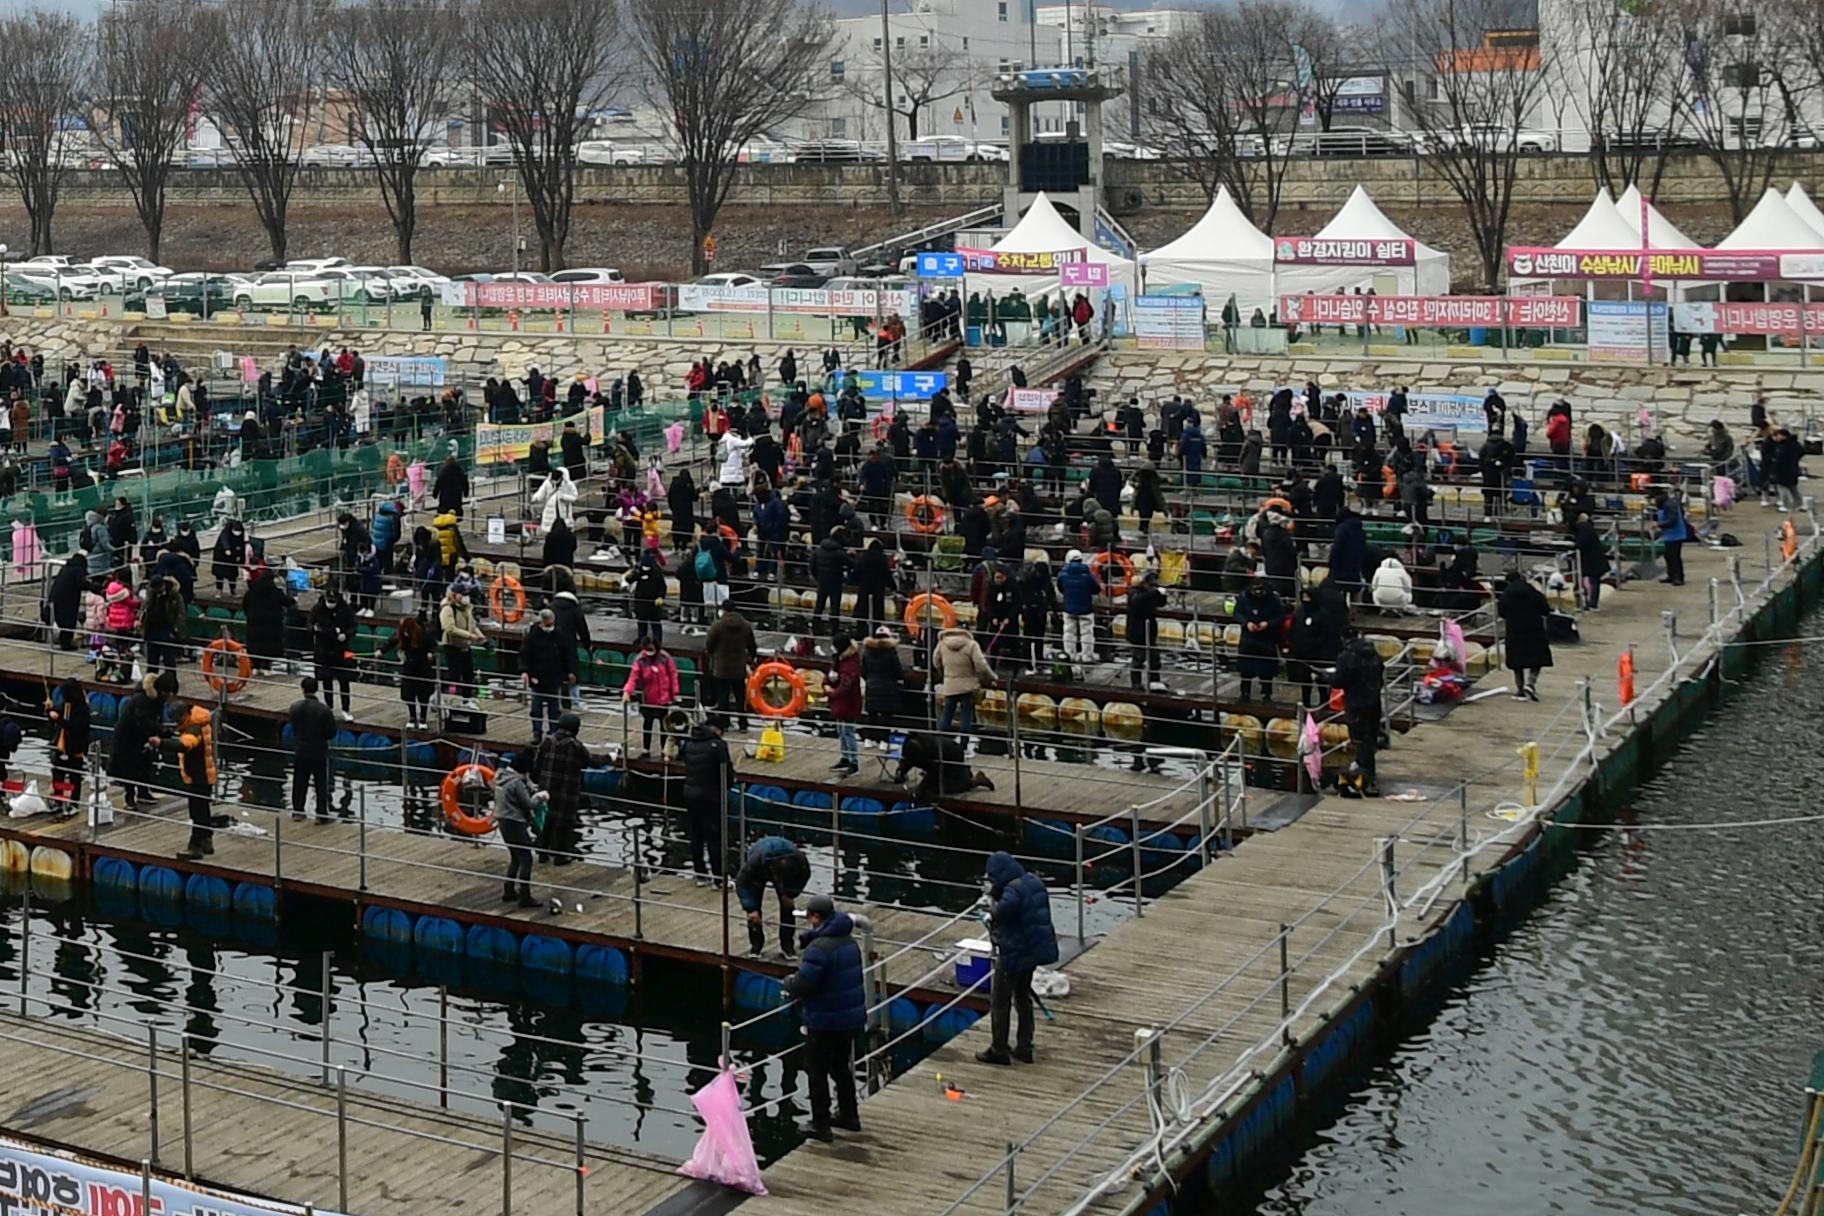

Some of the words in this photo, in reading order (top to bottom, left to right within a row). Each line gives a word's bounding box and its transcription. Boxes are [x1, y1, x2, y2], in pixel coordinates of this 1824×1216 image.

[1298, 241, 1371, 258] 환경지킴이
[1376, 242, 1406, 259] 쉼터
[1535, 256, 1576, 274] 산천어
